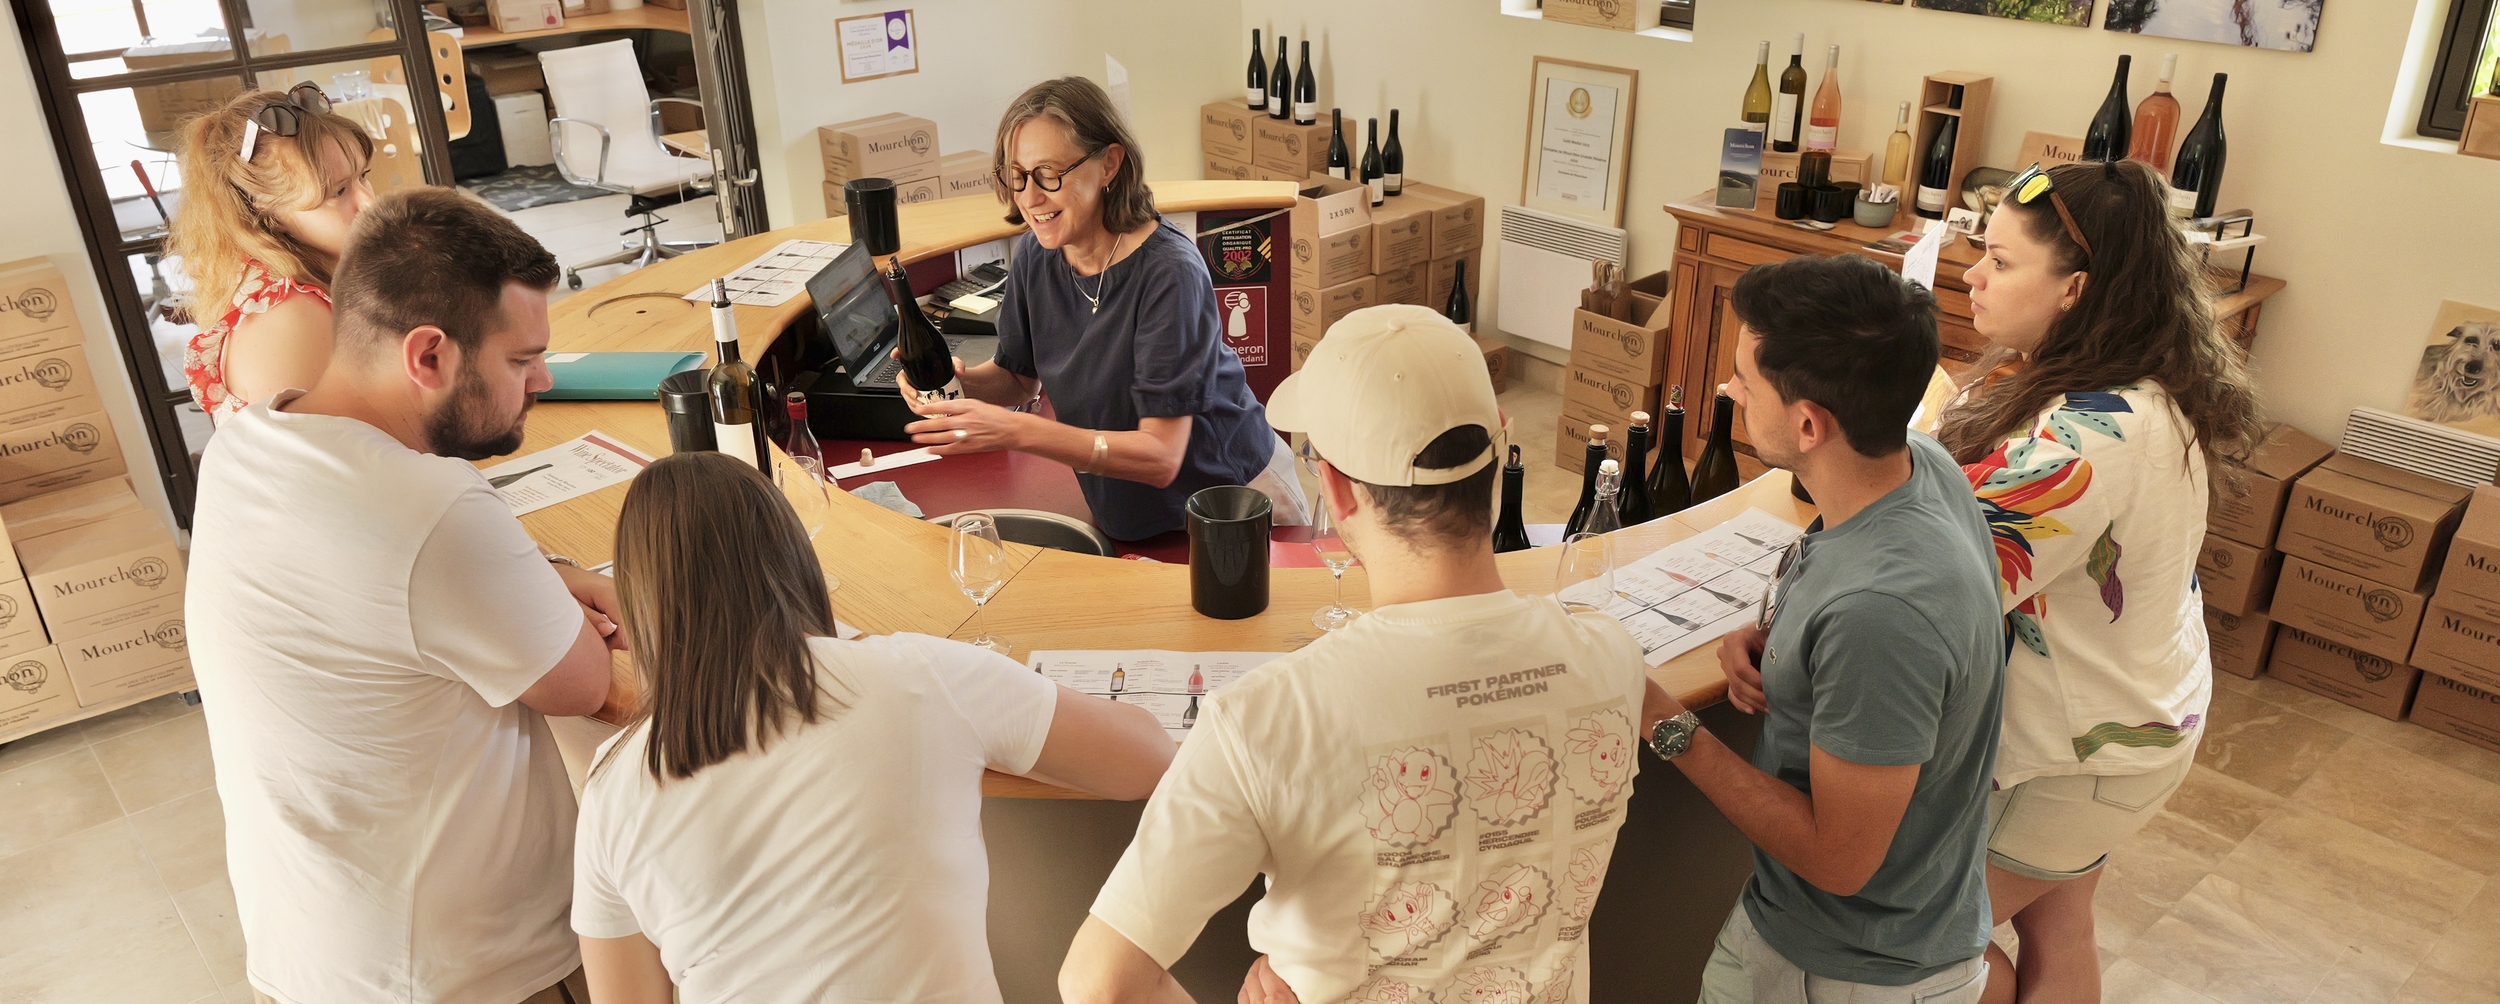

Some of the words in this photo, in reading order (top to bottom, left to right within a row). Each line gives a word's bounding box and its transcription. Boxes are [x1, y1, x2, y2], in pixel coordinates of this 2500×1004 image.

[846, 39, 870, 47] MÉDAILLE
[1206, 115, 1242, 132] Mourchon
[868, 135, 924, 154] Mourchon
[1259, 129, 1297, 146] Mourchon
[1210, 161, 1247, 179] Mourchon
[950, 173, 993, 191] Mourch
[1222, 250, 1252, 262] 2002
[1583, 320, 1637, 346] Mourchon
[1574, 371, 1627, 397] Mourchon
[569, 443, 593, 459] Wine
[2304, 495, 2402, 536] Mourchon
[53, 564, 156, 598] Mourchon
[2296, 566, 2391, 609] Mourchon
[81, 627, 180, 662] Mourchon
[2288, 629, 2382, 668] Mourchon
[1426, 678, 1482, 698] FIRST
[1486, 662, 1567, 690] PARTNER
[1456, 681, 1549, 708] POKÉMON
[1575, 815, 1610, 831] TORCHIC
[1479, 829, 1509, 839] #0155
[1479, 837, 1534, 852] CYNDAQUIL
[1377, 854, 1451, 868] CHARMANDER
